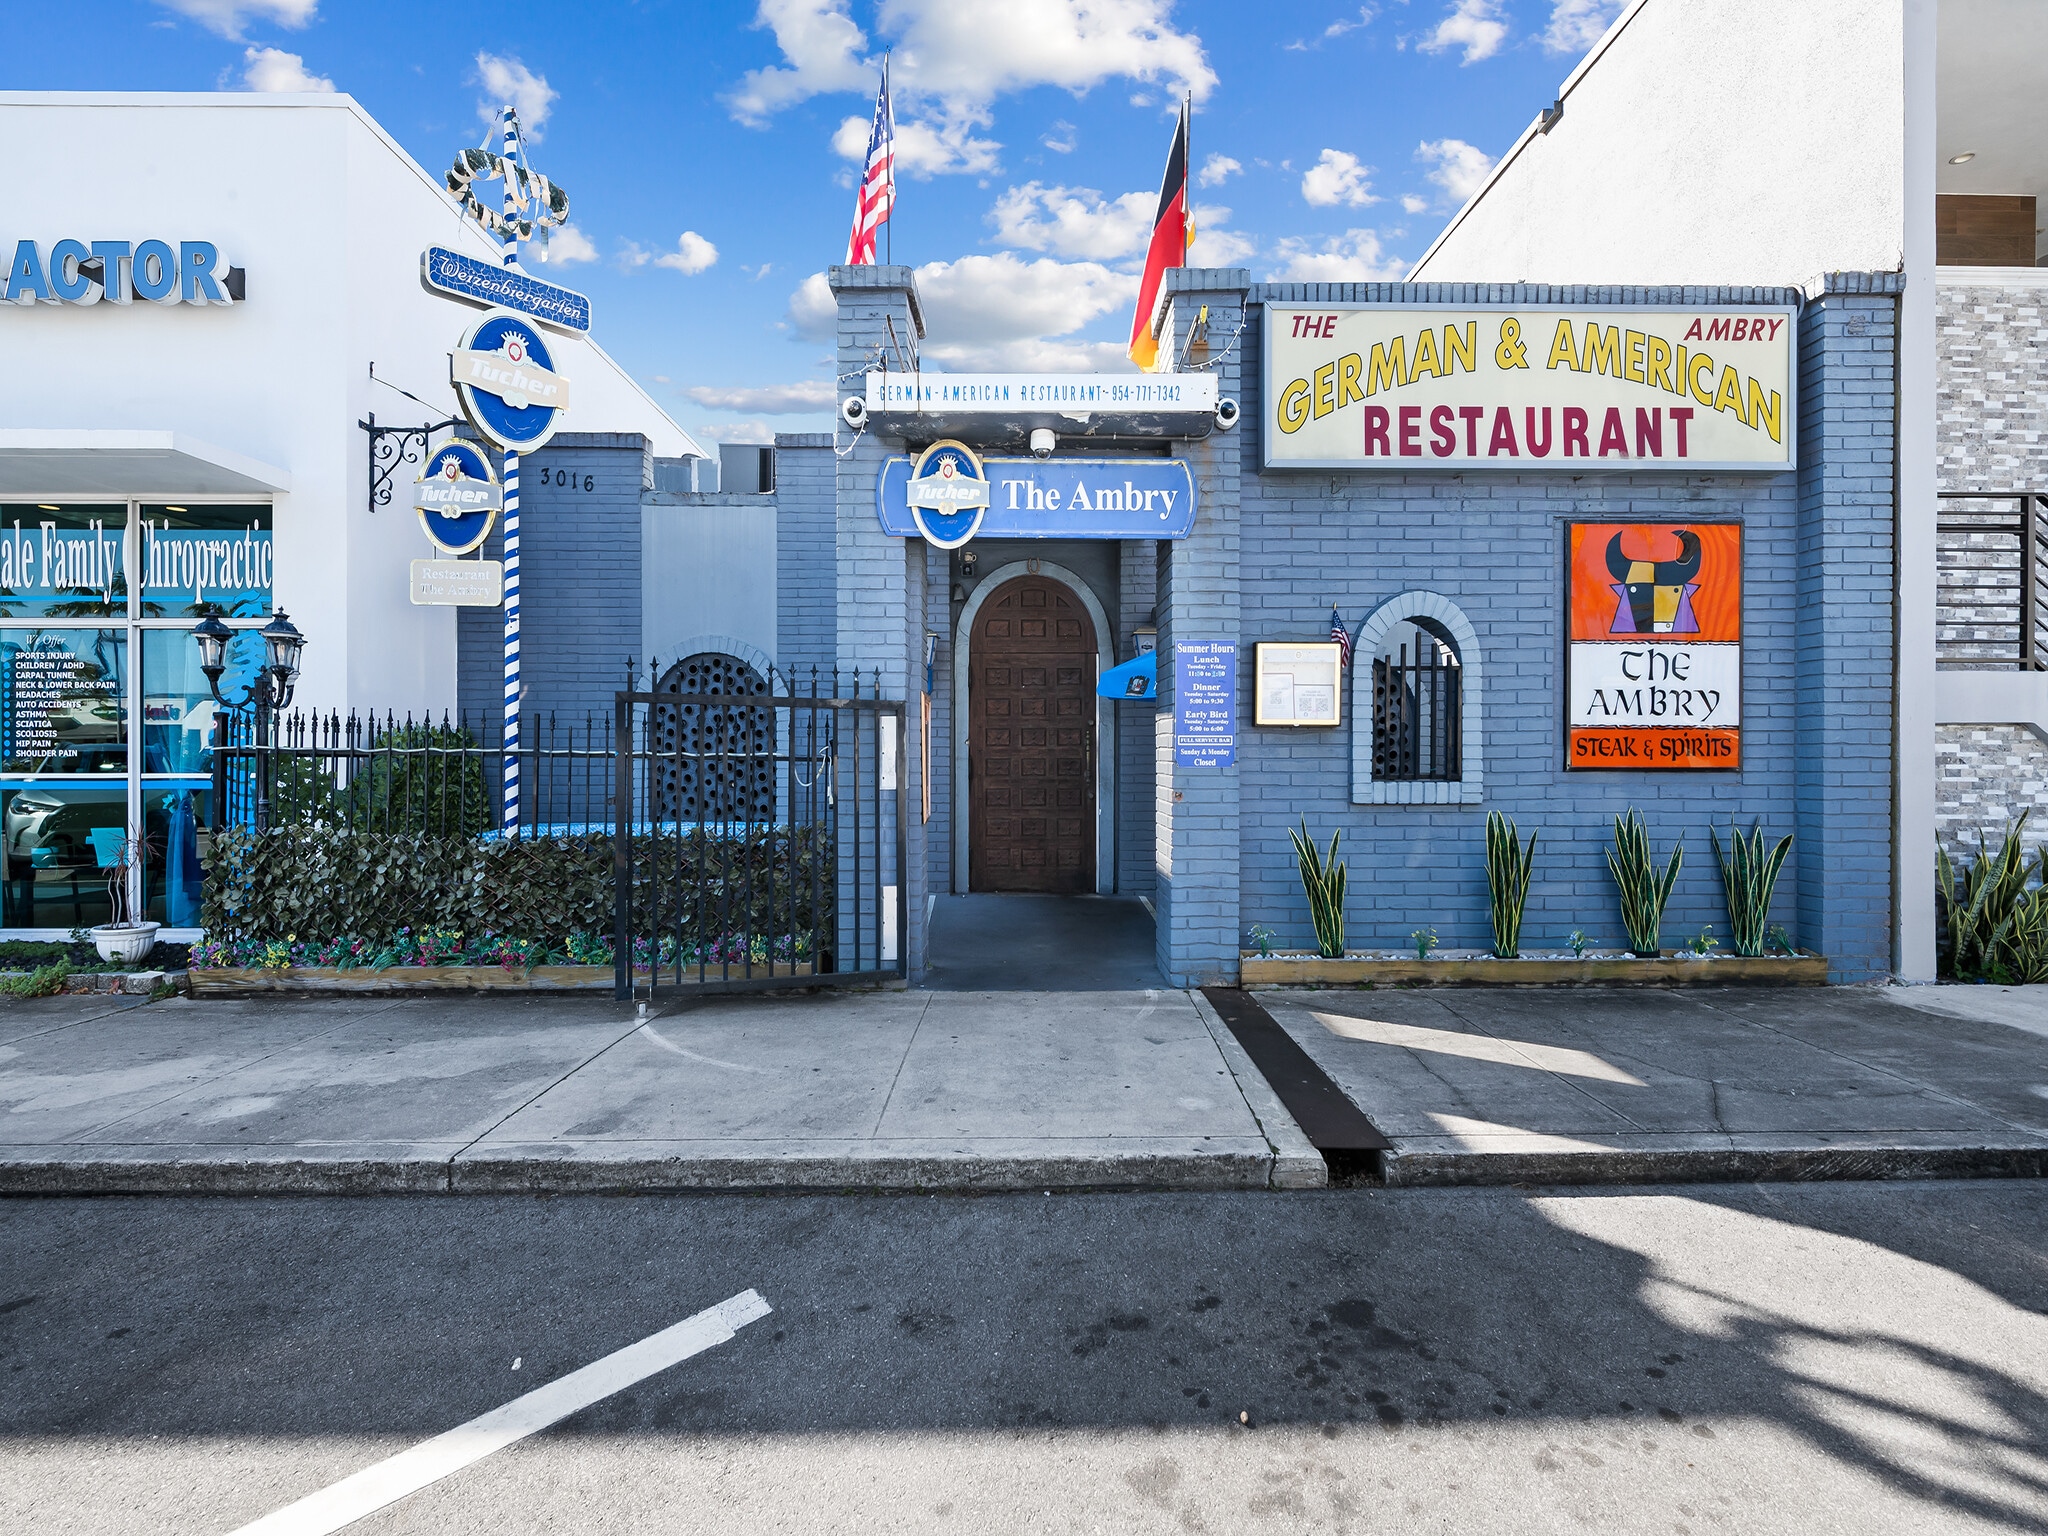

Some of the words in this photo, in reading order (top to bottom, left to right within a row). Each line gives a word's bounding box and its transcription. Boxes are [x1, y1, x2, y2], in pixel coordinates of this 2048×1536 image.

[0, 239, 223, 301] ACTOR
[440, 255, 582, 319] Weizenbiergarten
[1291, 315, 1338, 338] THE
[1683, 317, 1784, 342] AMBRY
[470, 357, 558, 396] Tucher
[1277, 320, 1478, 434] GERMAN
[1494, 317, 1530, 370] &
[1546, 318, 1782, 445] AMERICAN
[1363, 404, 1694, 458] RESTAURANT
[540, 468, 594, 492] 3016
[420, 485, 489, 504] Tucher
[917, 484, 981, 500] Tucher
[1001, 480, 1061, 511] The
[1068, 480, 1178, 520] Ambry
[0, 519, 34, 588] ale
[40, 519, 117, 604] Family
[122, 518, 272, 604] Chiropractic
[422, 567, 490, 580] Restaurant
[420, 583, 444, 595] The
[43, 634, 66, 648] Offer
[1177, 643, 1209, 653] Summer
[1211, 643, 1234, 653] Hours
[15, 651, 46, 660] SPORTS
[47, 651, 76, 660] INJURY
[1193, 656, 1220, 664] Lunch
[15, 661, 55, 670] CHILDREN
[62, 661, 85, 670] ADHD
[15, 671, 45, 679] CARPAL
[46, 671, 77, 679] TUNNEL
[15, 681, 36, 689] NECK
[37, 681, 44, 689] &
[45, 681, 73, 689] LOWER
[74, 681, 95, 689] BACK
[96, 681, 116, 689] PAIN
[1193, 683, 1221, 691] Dinner
[15, 691, 61, 699] HEADACHES
[37, 701, 82, 709] ACCIDENTS
[15, 710, 48, 718] ASTHMA
[1185, 711, 1208, 720] Early
[15, 720, 52, 728] SCIATICA
[15, 749, 58, 757] SHOULDER
[58, 749, 78, 757] PAIN
